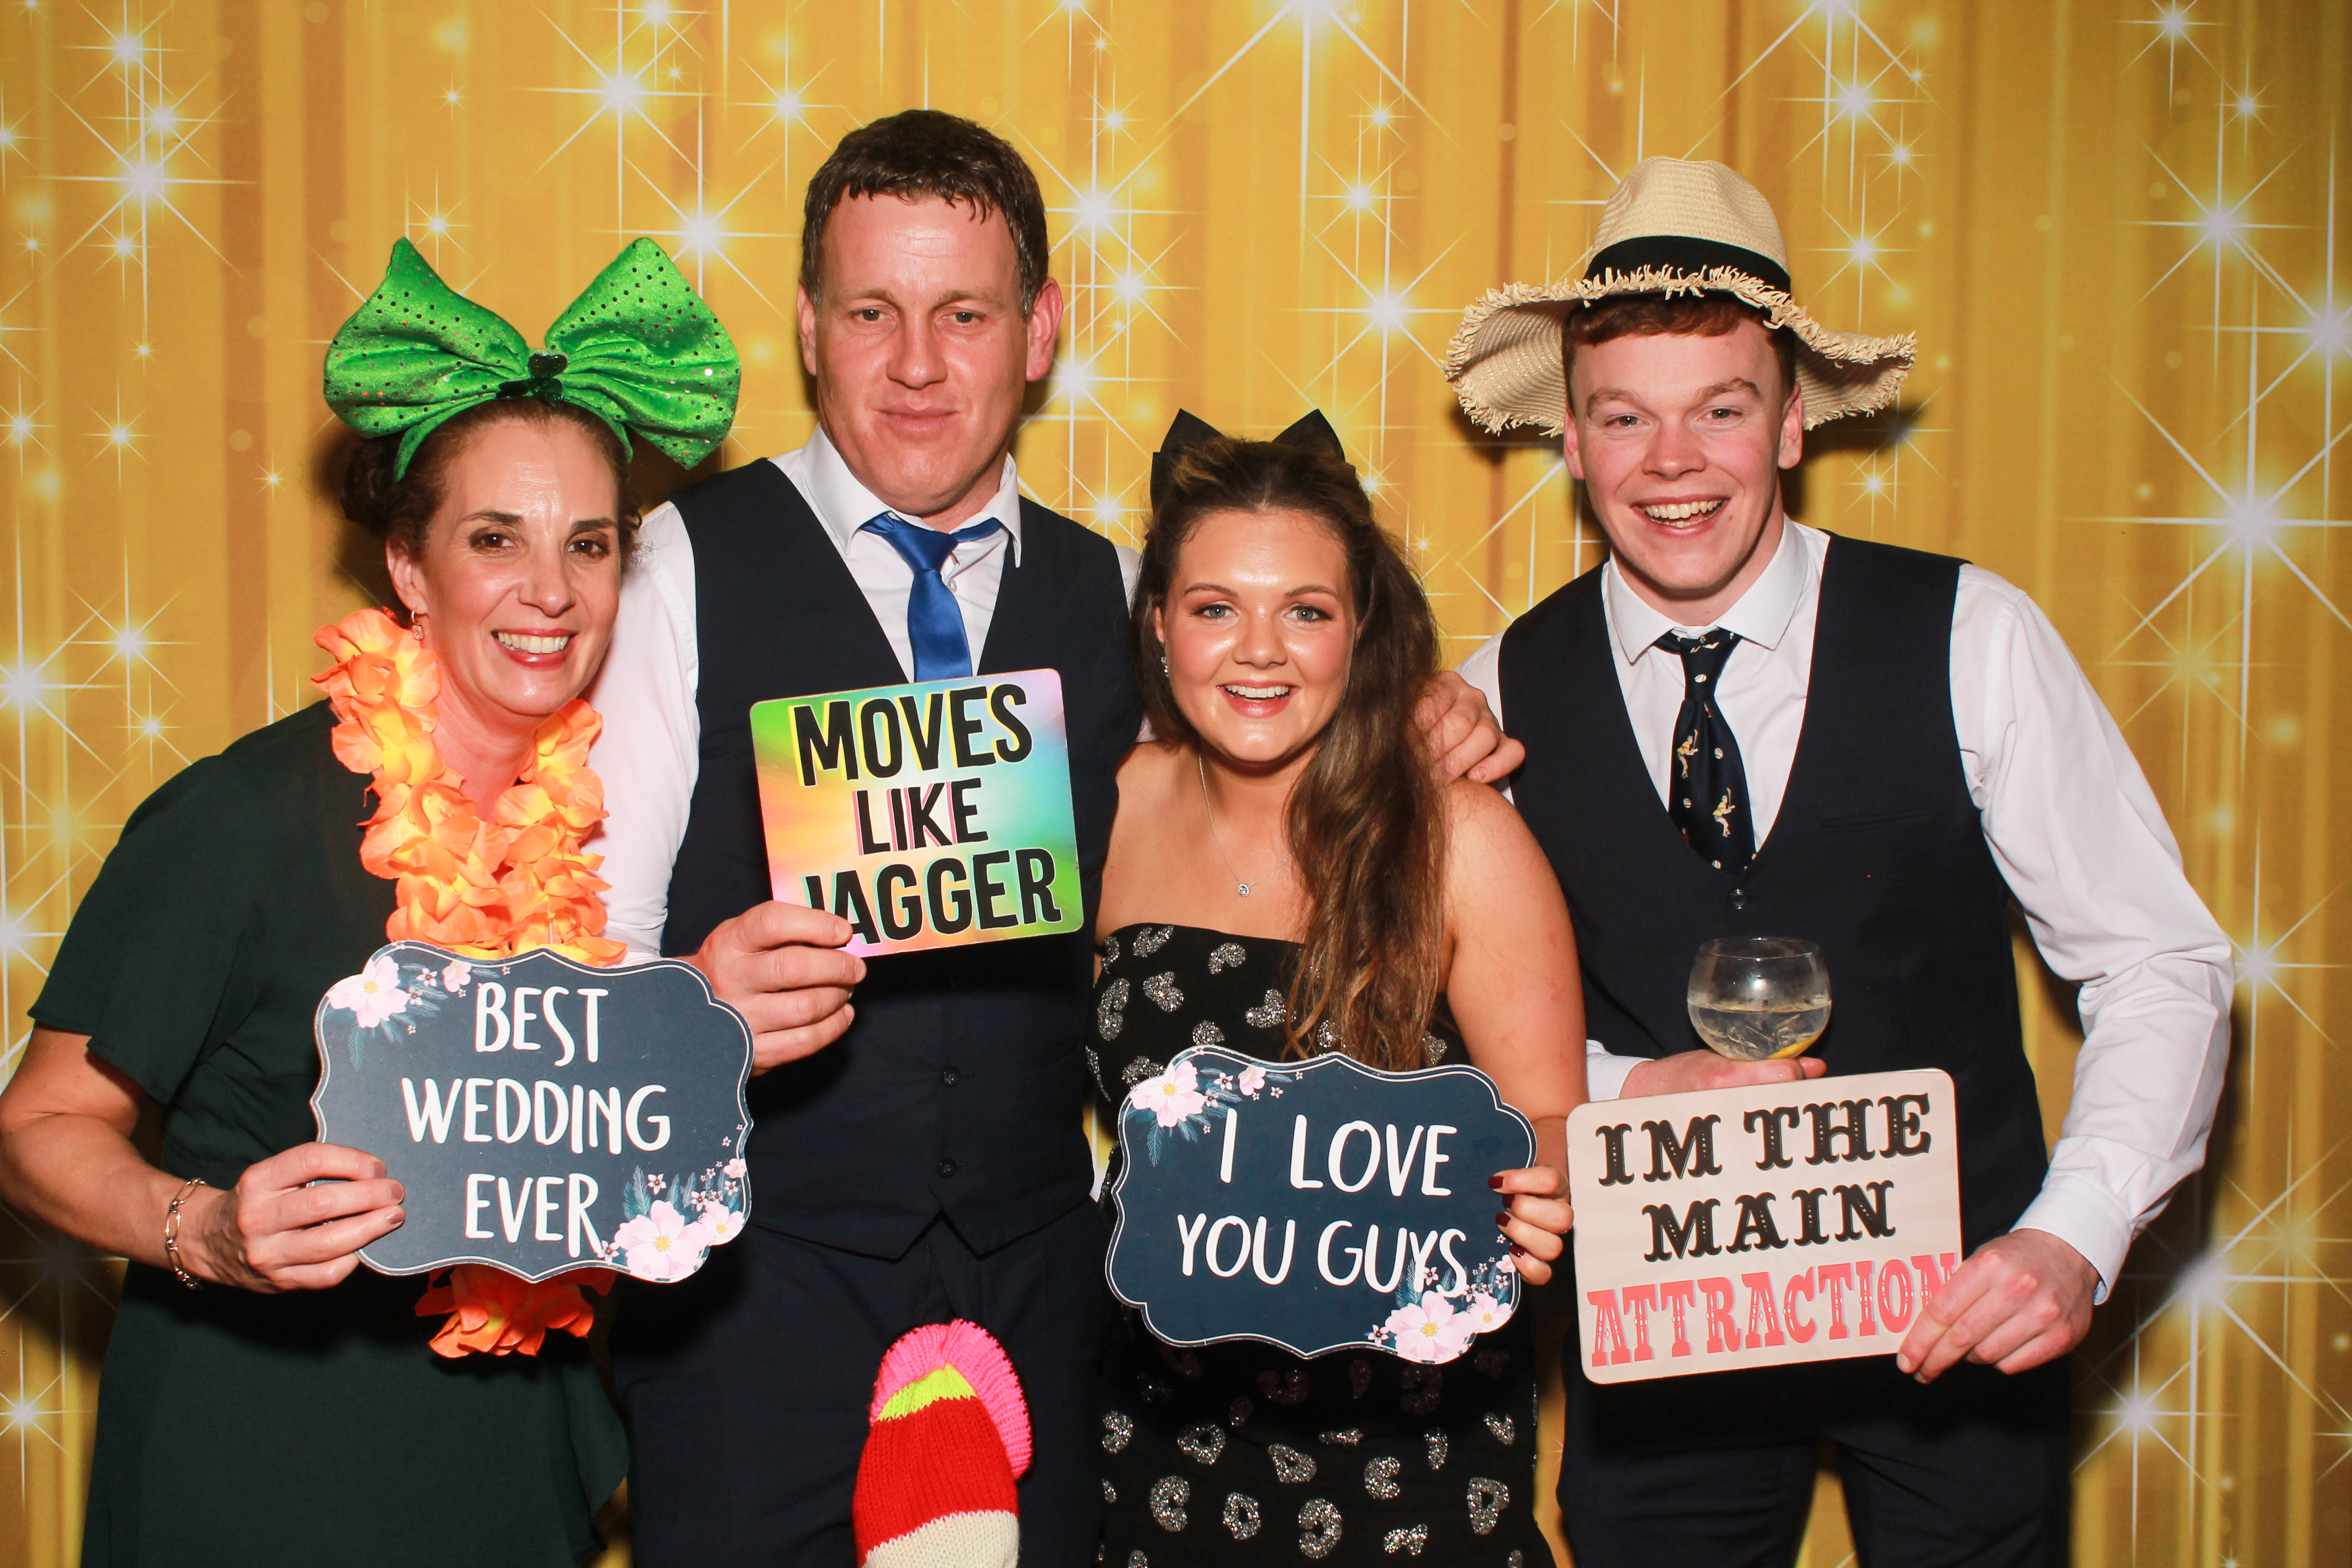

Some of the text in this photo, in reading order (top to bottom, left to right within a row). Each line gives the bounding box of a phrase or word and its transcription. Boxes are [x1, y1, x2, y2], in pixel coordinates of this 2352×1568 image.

[788, 684, 1033, 787] MOVES
[852, 778, 989, 856] LIKE
[475, 982, 609, 1067] BEST
[401, 1077, 671, 1155] WEDDING
[1219, 1108, 1458, 1197] I LOVE
[1595, 1092, 1931, 1186] IM THE
[465, 1173, 602, 1258] EVER
[1177, 1213, 1469, 1298] YOU GUYS
[1642, 1180, 1896, 1262] MAIN
